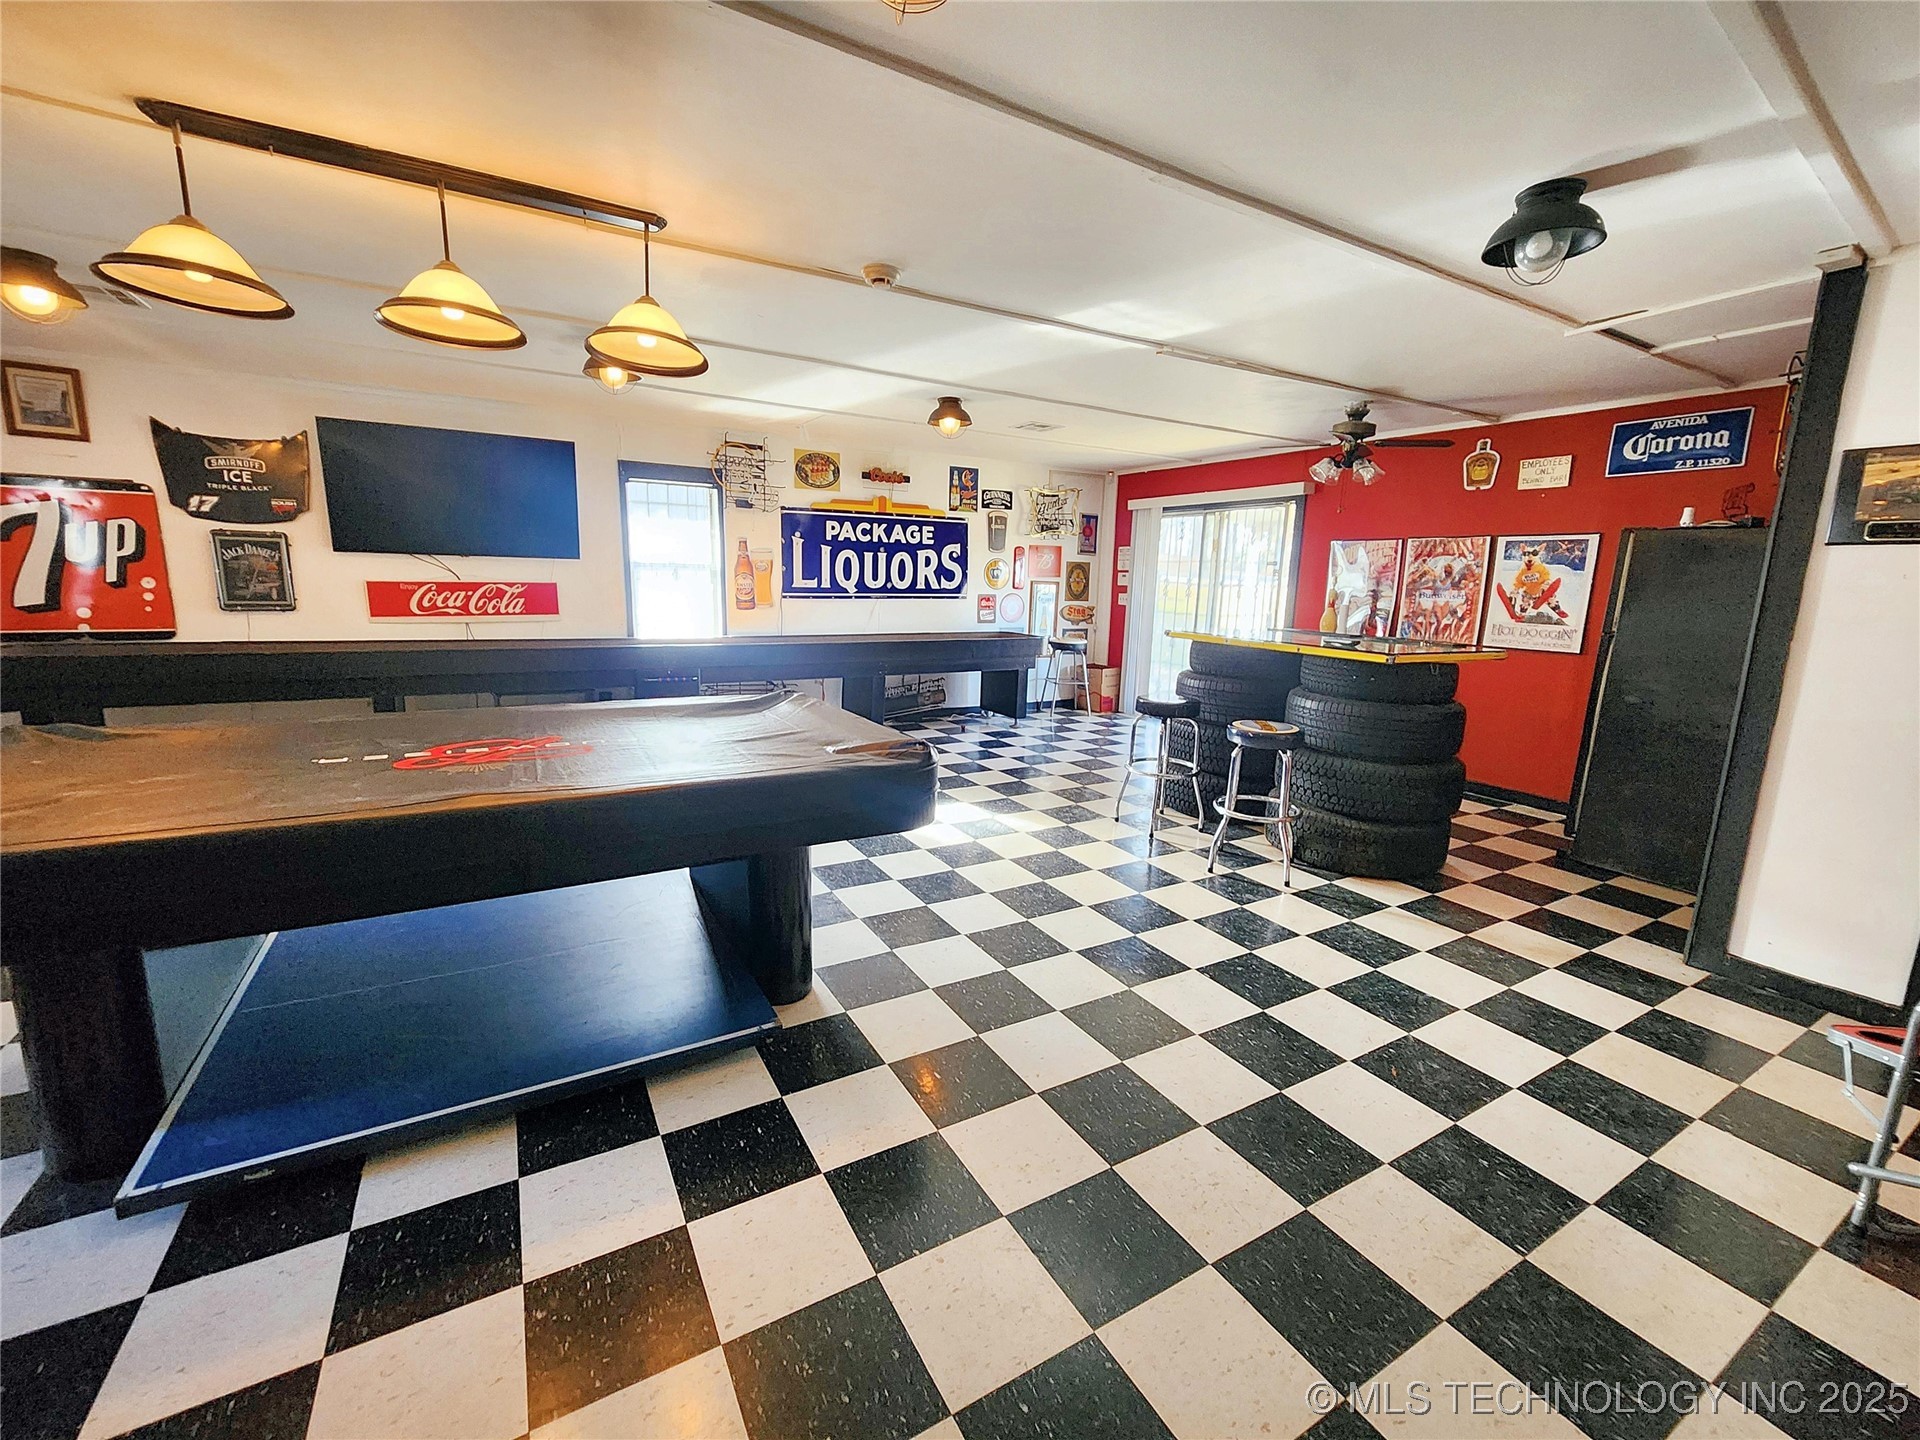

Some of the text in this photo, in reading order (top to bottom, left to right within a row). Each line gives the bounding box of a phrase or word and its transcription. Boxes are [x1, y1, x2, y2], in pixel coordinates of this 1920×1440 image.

[1650, 415, 1709, 431] AVENIDA
[1623, 430, 1730, 462] Corona
[210, 458, 261, 470] SMIRNOFF
[1521, 457, 1570, 470] EMPLOYEES
[223, 470, 253, 483] ICE
[1534, 467, 1557, 476] ONLY
[206, 482, 238, 490] TRIPLE
[983, 491, 1011, 502] GUINNESS
[189, 495, 220, 512] 17
[825, 520, 935, 545] PACKAGE
[221, 546, 245, 561] JACK
[791, 543, 963, 594] LIQUORS
[409, 583, 528, 615] Coca-Cola
[1067, 605, 1087, 618] Stag
[1491, 623, 1517, 636] HOT
